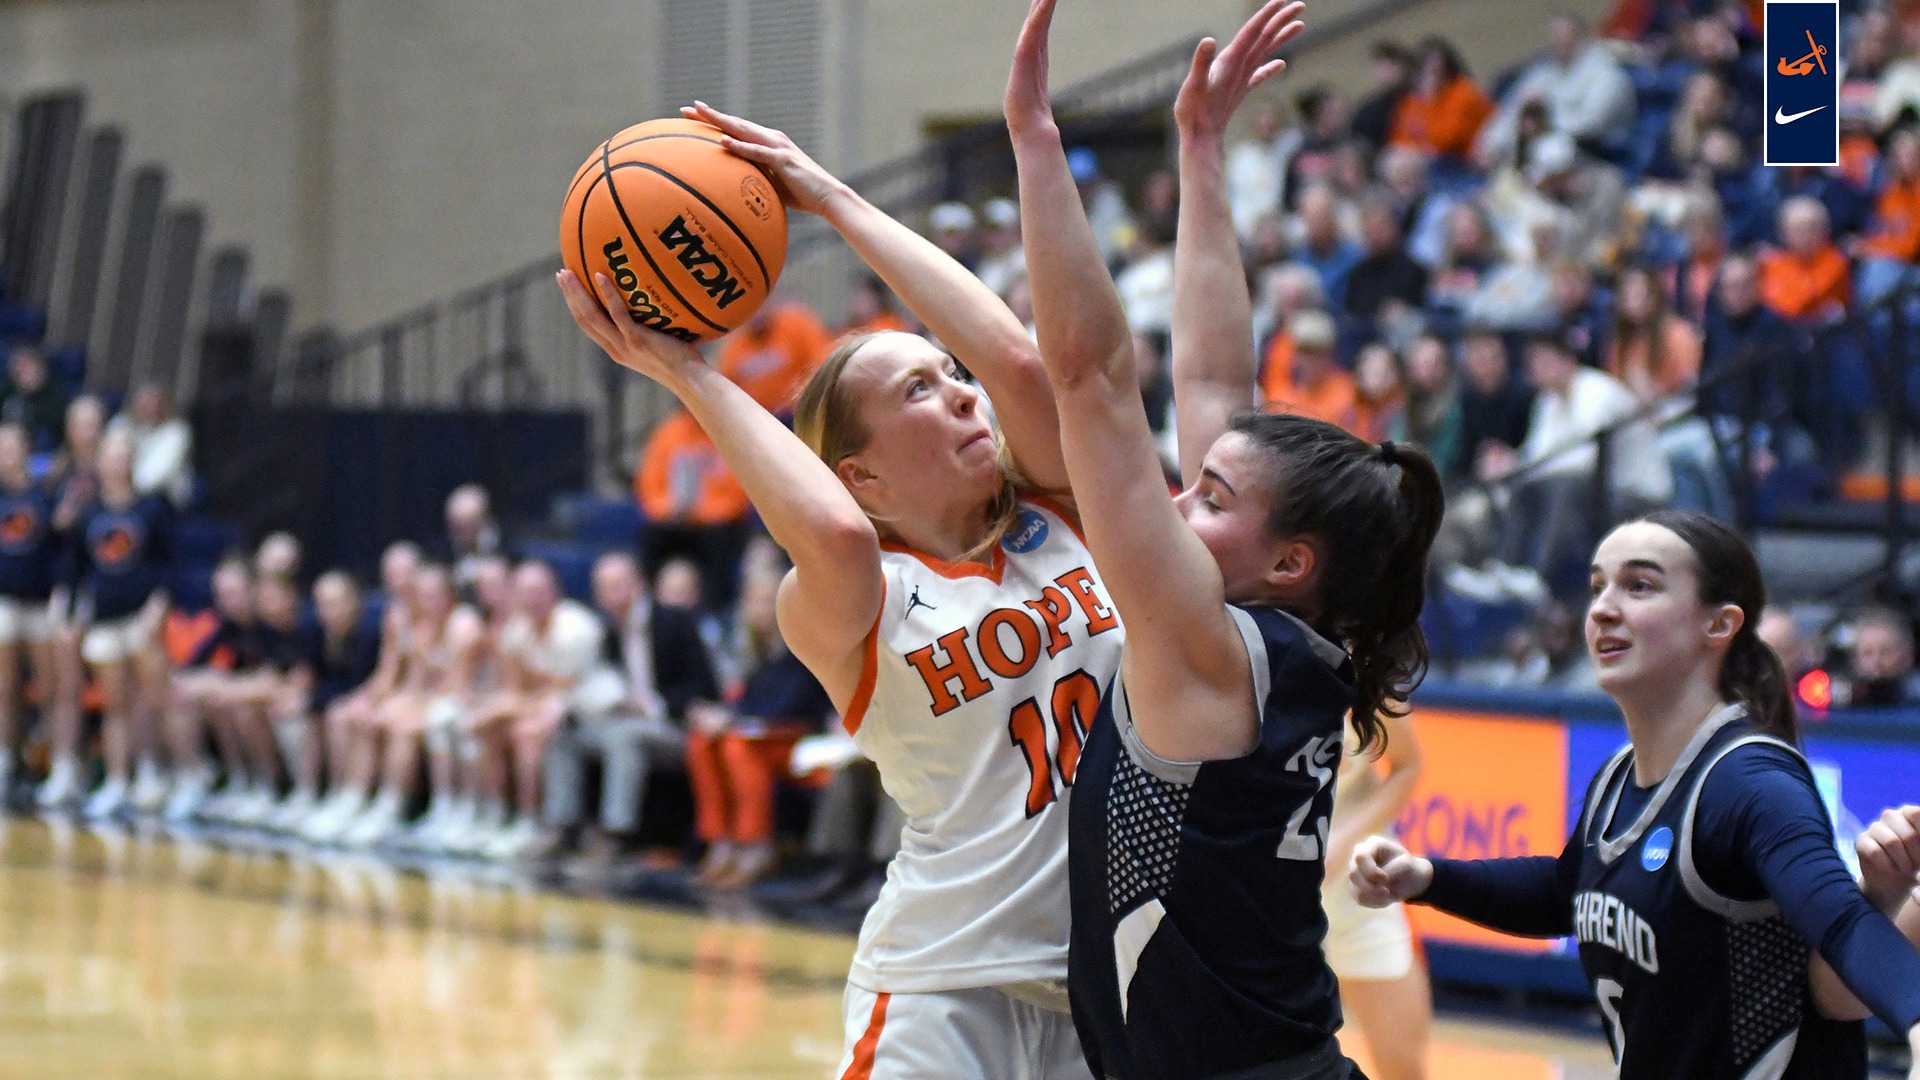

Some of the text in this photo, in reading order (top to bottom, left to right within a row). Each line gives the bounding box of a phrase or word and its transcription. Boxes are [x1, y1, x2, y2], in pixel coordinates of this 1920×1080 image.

[657, 214, 747, 310] NCAA
[685, 207, 706, 233] BALL
[705, 233, 729, 259] GAME
[1012, 519, 1046, 549] NCAA
[904, 566, 1119, 717] HOPE
[1008, 668, 1101, 820] 10
[1276, 730, 1344, 861] 2
[1575, 891, 1659, 975] HREND
